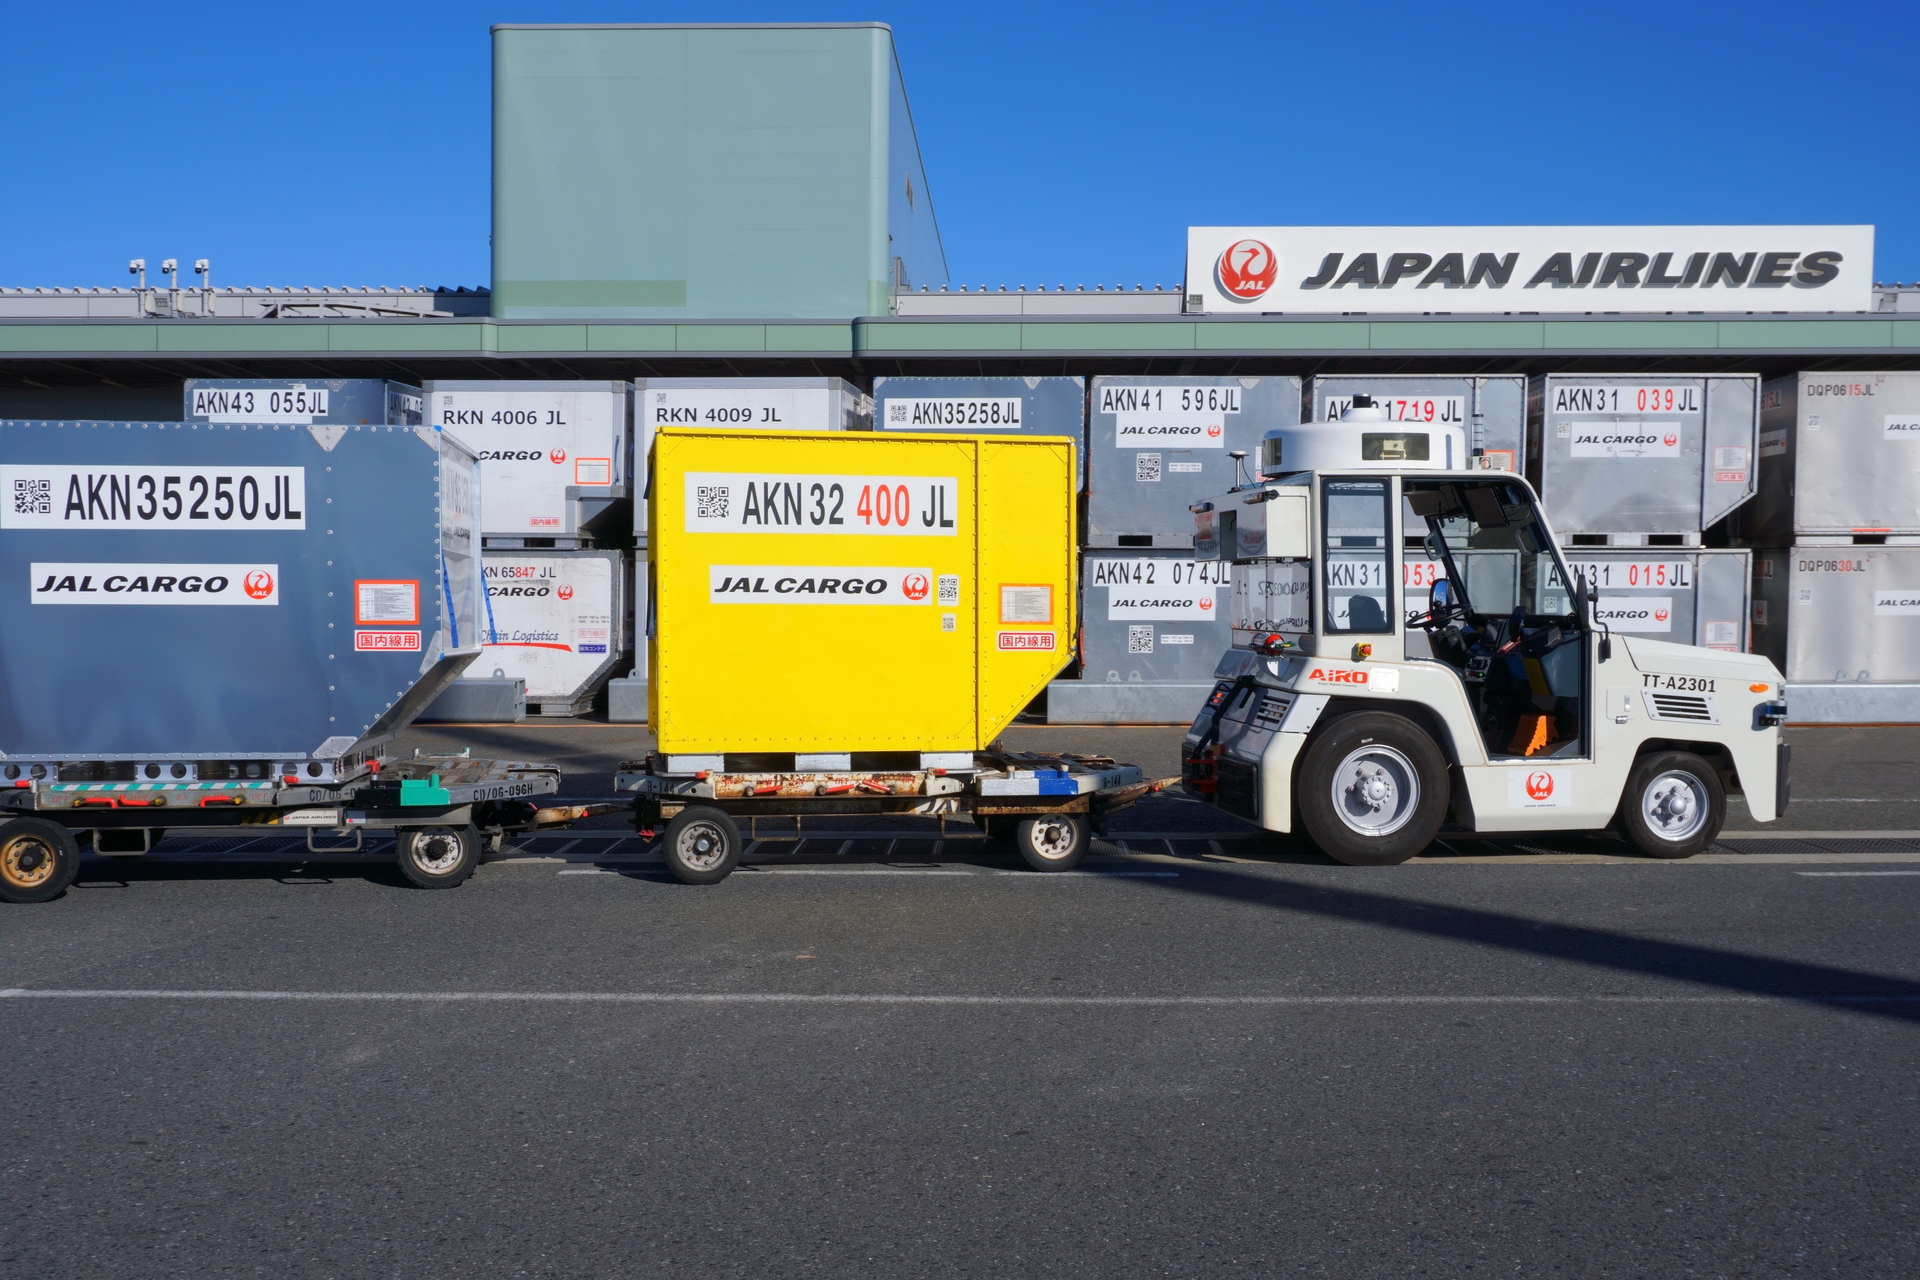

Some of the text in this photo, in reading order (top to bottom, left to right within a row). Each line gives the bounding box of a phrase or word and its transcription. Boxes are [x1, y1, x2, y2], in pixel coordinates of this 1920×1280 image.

[1303, 251, 1844, 288] JAPAN AIRLINES
[1234, 279, 1266, 290] JAL
[195, 391, 327, 414] AKN43 055JL
[1102, 388, 1239, 412] AKN41 596JL
[1556, 388, 1619, 411] AKN31
[443, 410, 567, 425] RKN 4006 JL
[656, 408, 782, 423] RKN 4009 JL
[912, 401, 1020, 425] AKN35258JL
[1441, 400, 1462, 422] JL
[1120, 426, 1145, 435] JAL
[1147, 426, 1202, 435] CARGO
[1574, 435, 1600, 444] JAL
[1602, 435, 1657, 444] CARGO
[479, 450, 542, 461] CARGO
[64, 474, 302, 521] AKN35250JL
[741, 481, 954, 528] AKN32 400 JL
[501, 566, 536, 578] 65847
[1095, 562, 1155, 585] AKN42
[37, 575, 229, 594] JAL CARGO
[487, 587, 550, 597] CARGO
[714, 577, 888, 595] JAL CARGO
[1112, 599, 1138, 608] JAL
[1139, 599, 1193, 608] CARGO
[1596, 610, 1649, 619] CARGO
[361, 635, 415, 647] 国内線用
[511, 630, 559, 644] Logistics
[1002, 635, 1051, 647] 国内線用
[1642, 674, 1716, 693] TT-A2301
